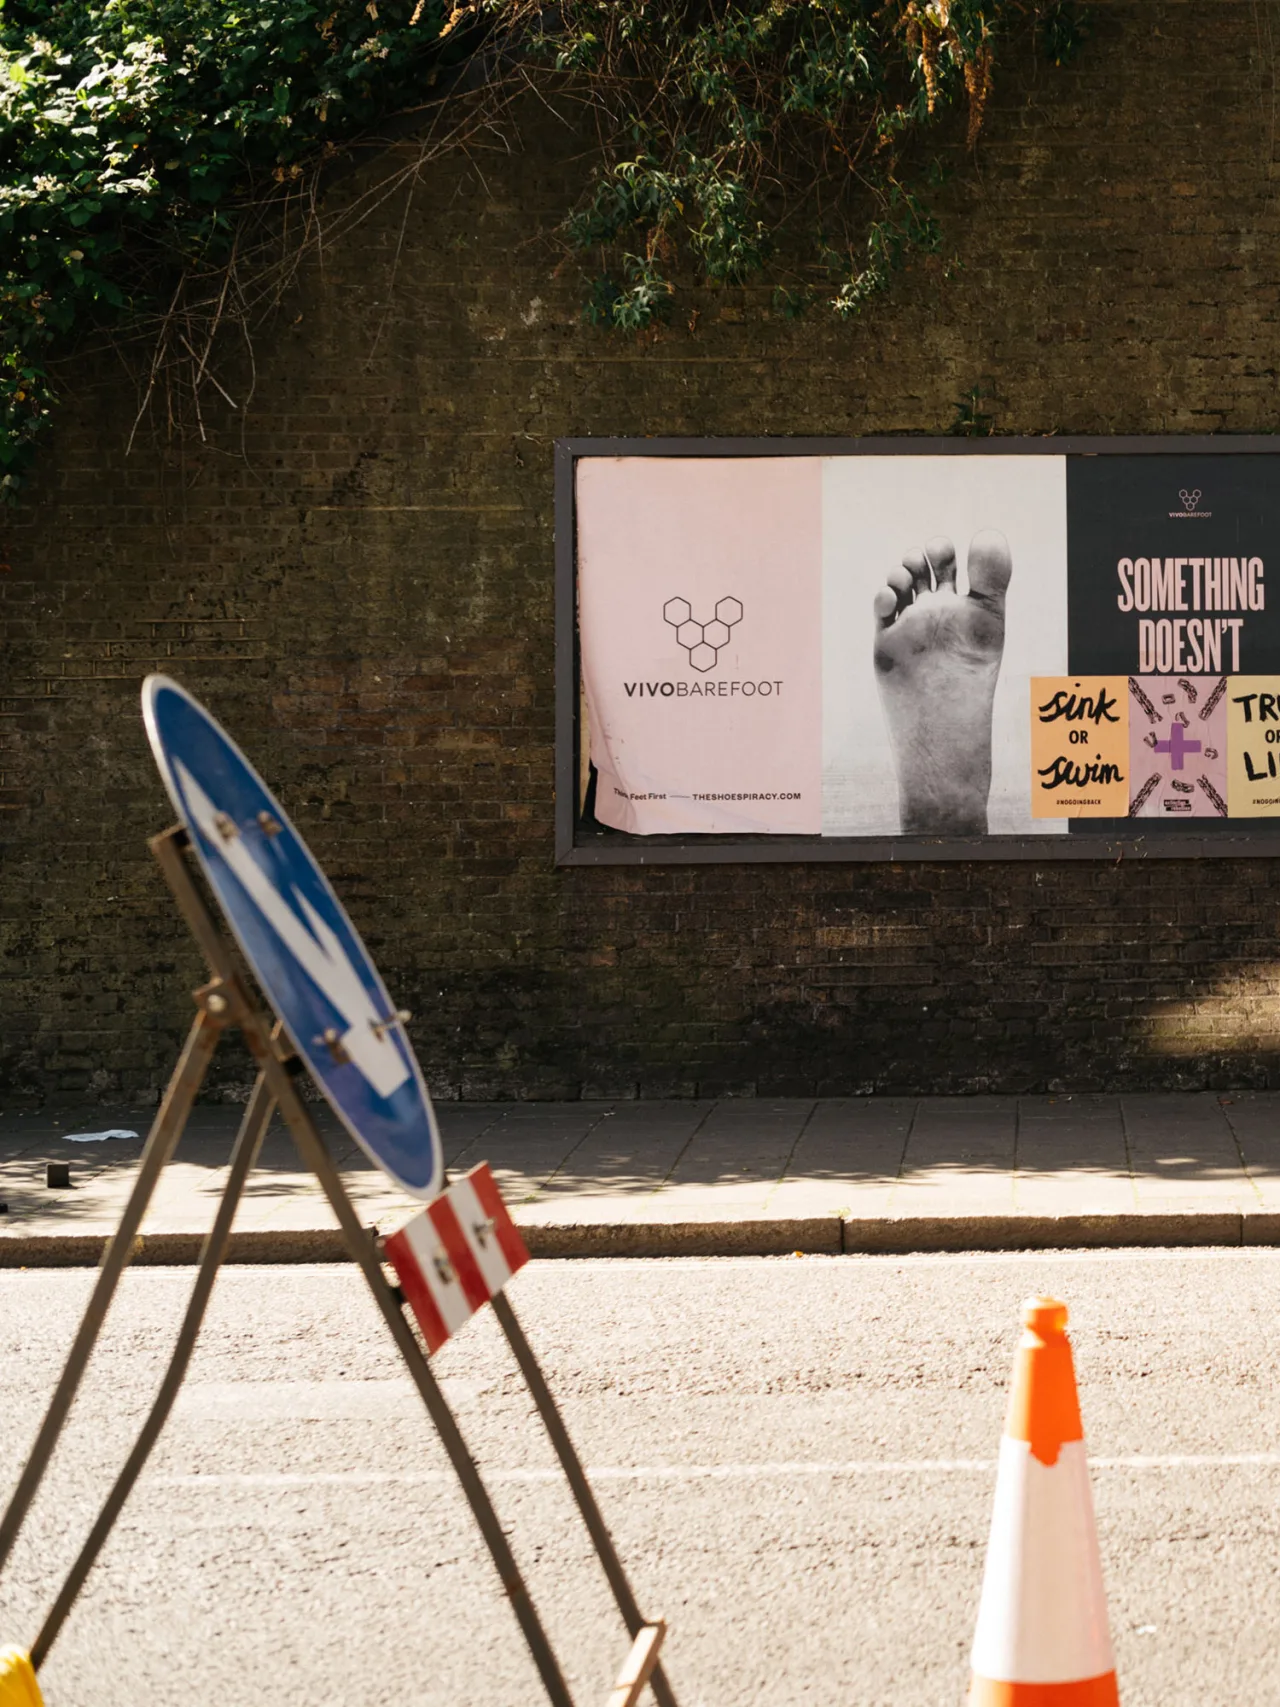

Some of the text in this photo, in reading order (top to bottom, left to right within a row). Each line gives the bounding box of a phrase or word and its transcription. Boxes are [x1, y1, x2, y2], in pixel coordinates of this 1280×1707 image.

[1117, 557, 1265, 612] SOMETHING
[1138, 618, 1244, 673] DOESN'T
[624, 681, 783, 697] VIVOBAREFOOT
[1038, 683, 1121, 724] sink
[1069, 730, 1088, 744] OR
[1037, 754, 1124, 790] swim
[648, 792, 666, 800] First
[692, 793, 801, 801] THESHOESPIRACY.COM
